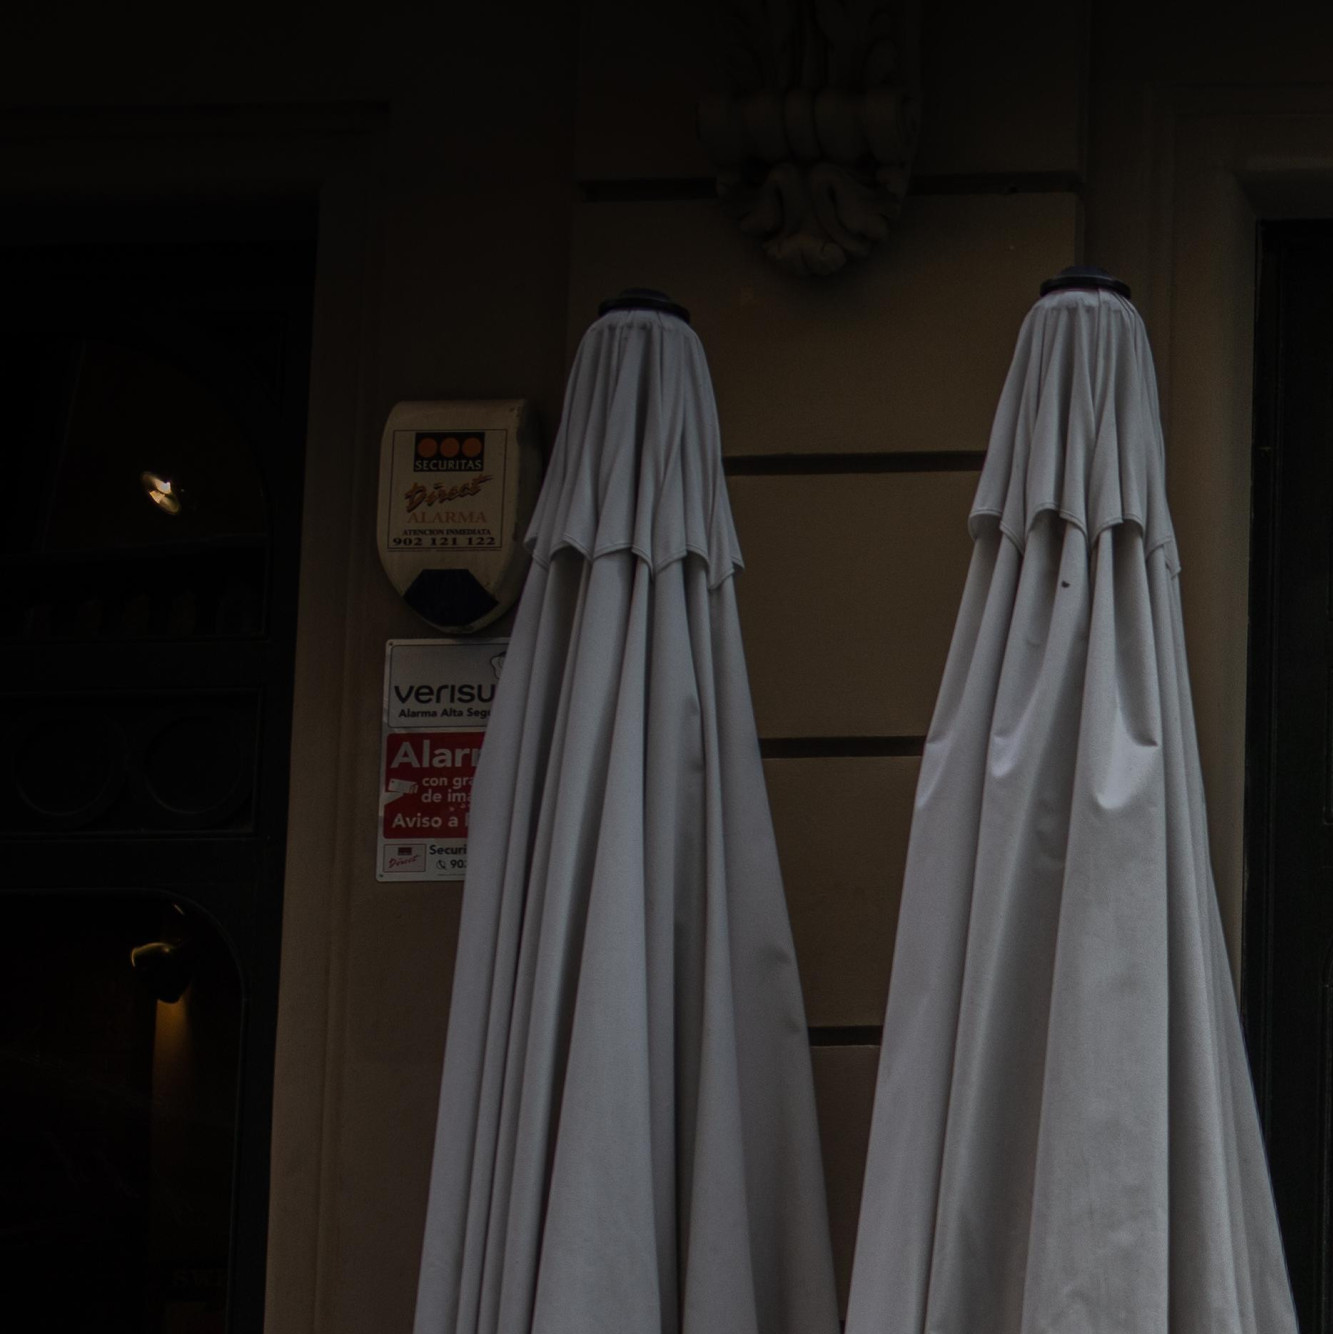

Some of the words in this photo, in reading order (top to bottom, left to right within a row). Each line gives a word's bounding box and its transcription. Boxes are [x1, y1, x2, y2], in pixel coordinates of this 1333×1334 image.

[414, 459, 483, 471] SECURITAS
[407, 511, 487, 524] ALARMA
[446, 528, 491, 536] INMEDIATA
[393, 537, 423, 546] 902
[430, 537, 457, 546] 121
[467, 536, 496, 546] 122
[398, 708, 437, 718] Alarma
[440, 708, 464, 718] Alta
[421, 777, 448, 787] con
[421, 789, 443, 804] de
[391, 813, 442, 829] Aviso
